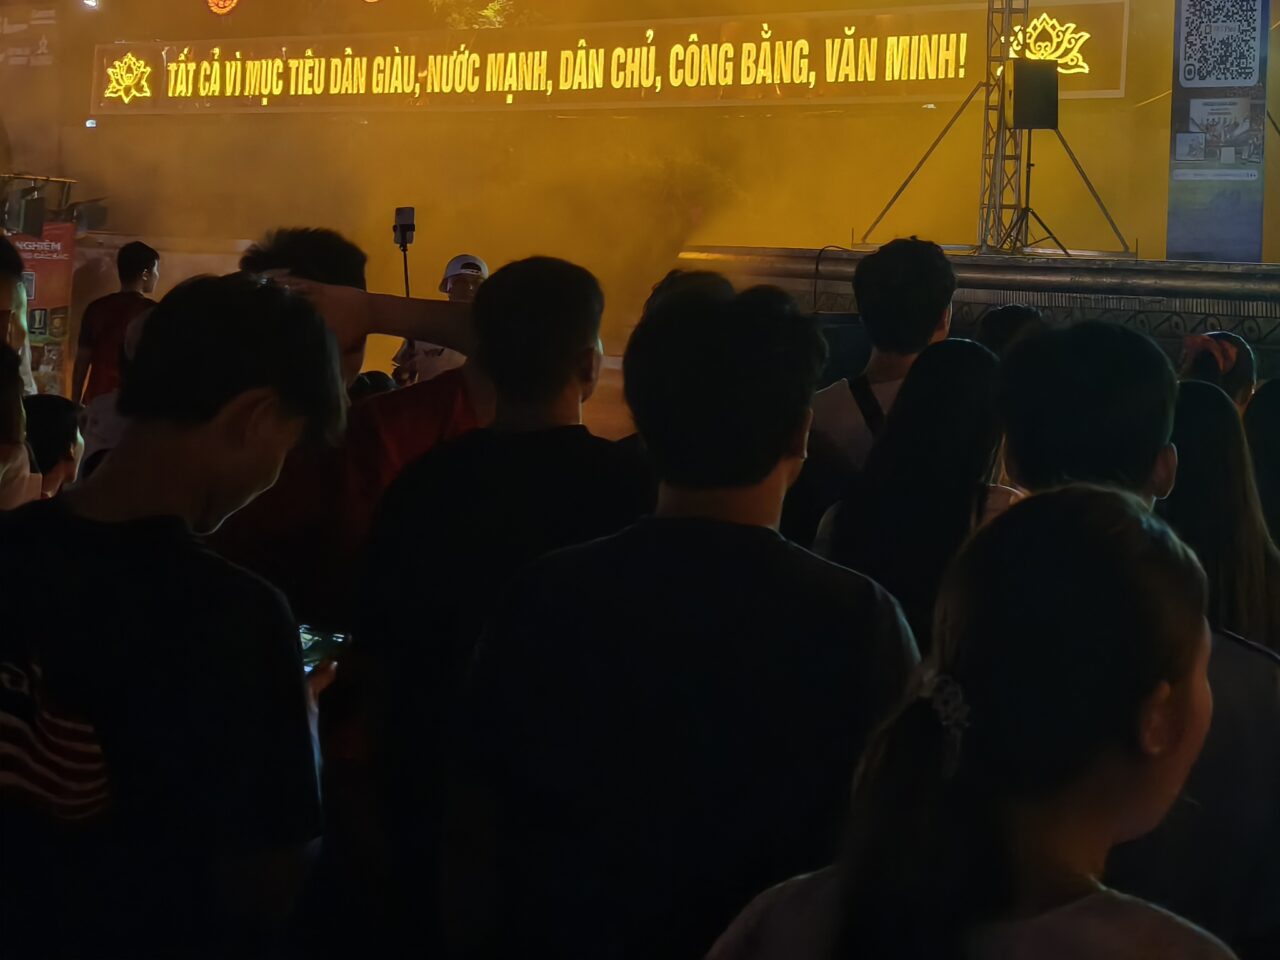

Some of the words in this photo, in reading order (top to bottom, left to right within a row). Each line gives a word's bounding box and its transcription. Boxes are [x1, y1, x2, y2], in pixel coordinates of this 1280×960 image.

[167, 47, 196, 96] TẤT
[198, 47, 220, 97] CẢ
[225, 51, 242, 96] VÌ
[244, 58, 284, 106] MỤC
[288, 48, 326, 95] TIÊU
[330, 49, 368, 95] DÂN
[427, 43, 480, 94] NƯỚC
[486, 50, 552, 104] MẠNH,
[559, 38, 605, 91] DÂN
[610, 28, 661, 93] CHỦ,
[669, 35, 734, 87] CÔNG
[741, 22, 816, 88] BẰNG,
[825, 25, 878, 82] VĂN
[885, 32, 967, 81] MINH!
